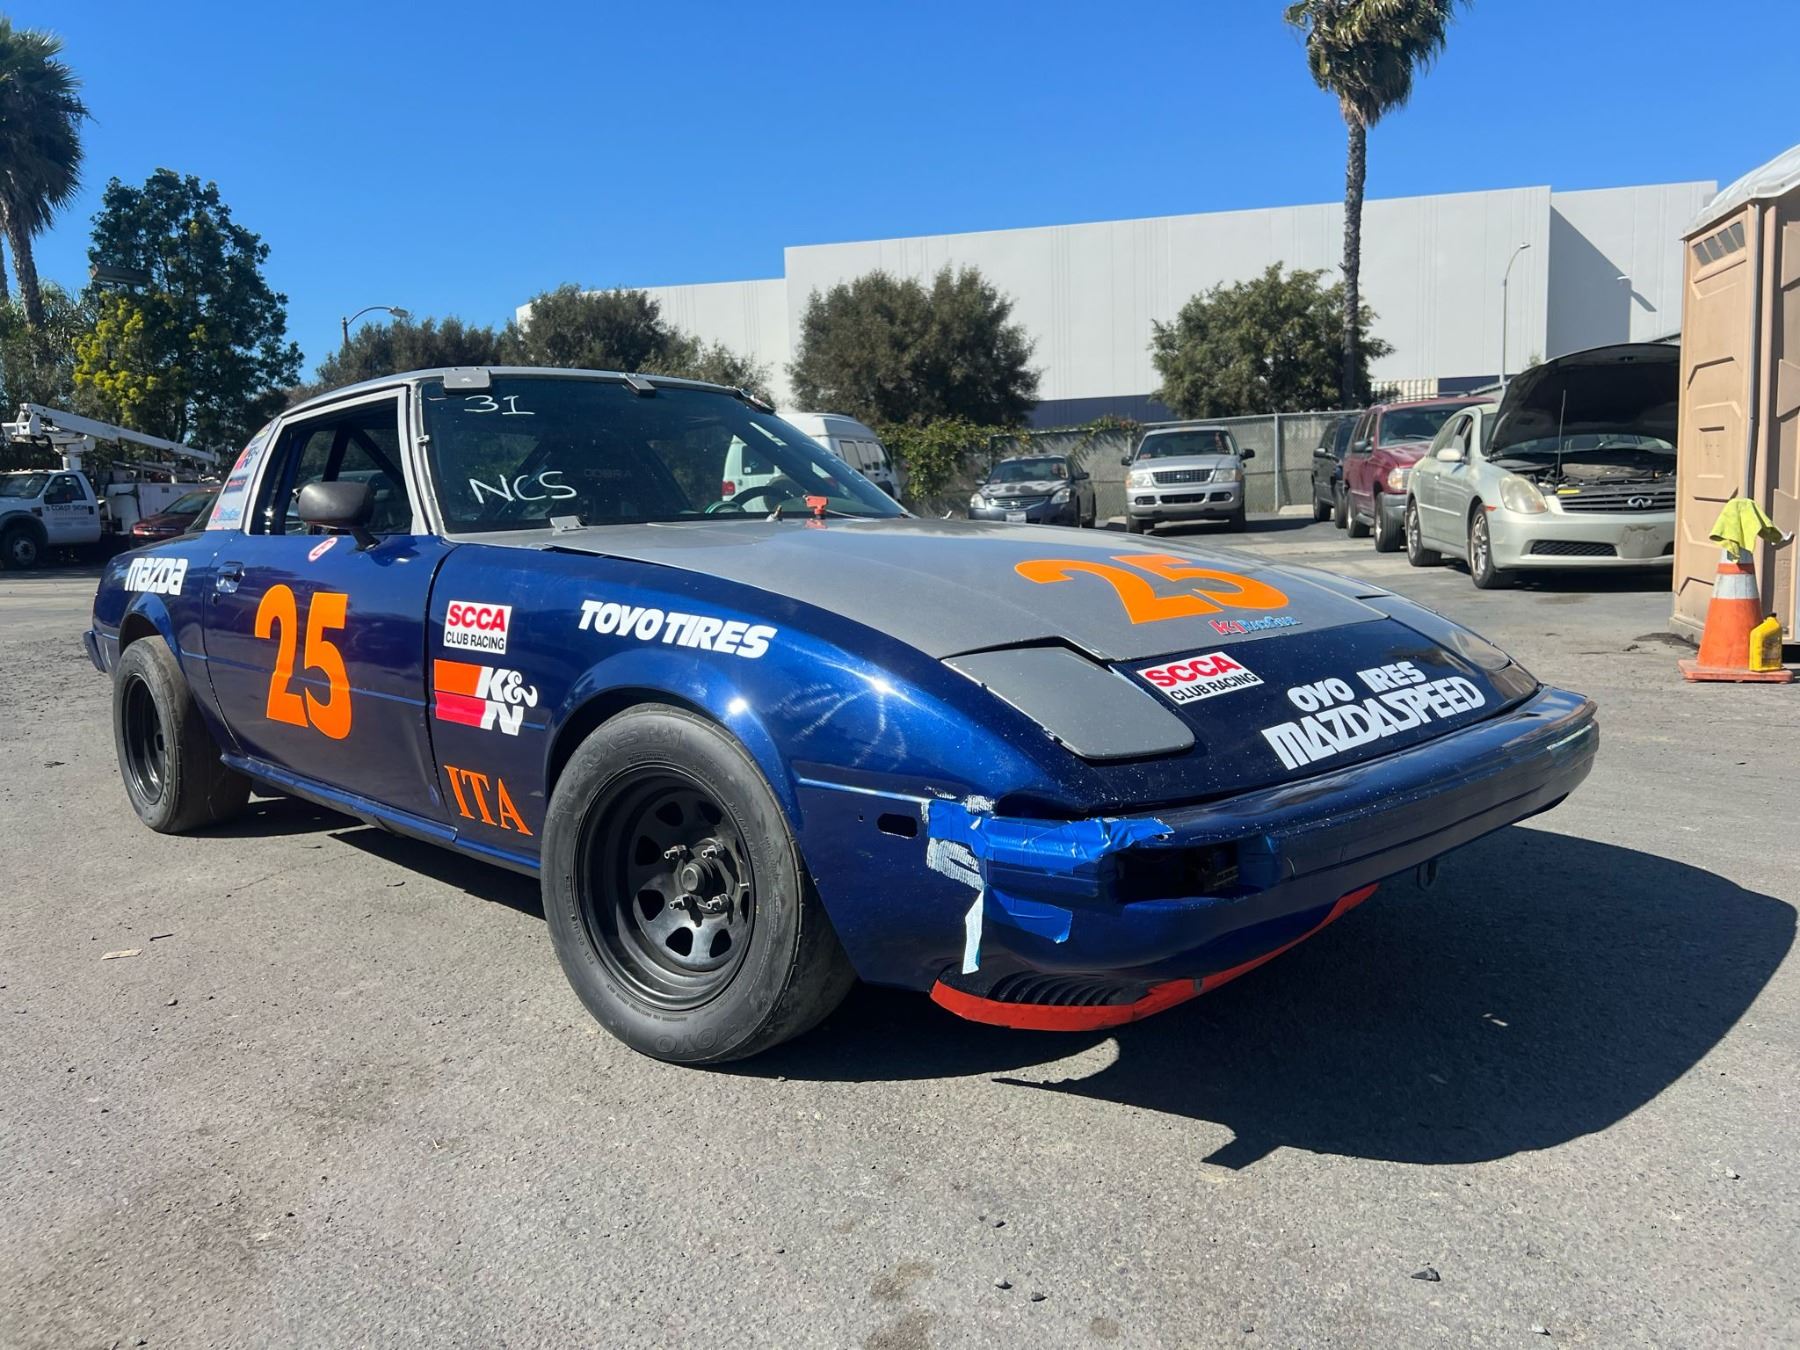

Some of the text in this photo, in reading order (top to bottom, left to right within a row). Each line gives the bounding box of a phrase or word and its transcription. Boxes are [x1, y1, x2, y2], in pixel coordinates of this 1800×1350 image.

[464, 395, 535, 415] 31
[468, 471, 577, 504] NCS
[1014, 553, 1290, 625] 25
[447, 604, 507, 632] SCCA
[578, 599, 778, 659] TOYO TIRES
[445, 631, 506, 651] CLUB RACING
[254, 583, 353, 740] 25
[1144, 655, 1243, 687] SCCA
[1170, 672, 1260, 703] CLUB RACING
[1260, 675, 1487, 771] MAZDASPEED
[444, 764, 534, 837] ITA
